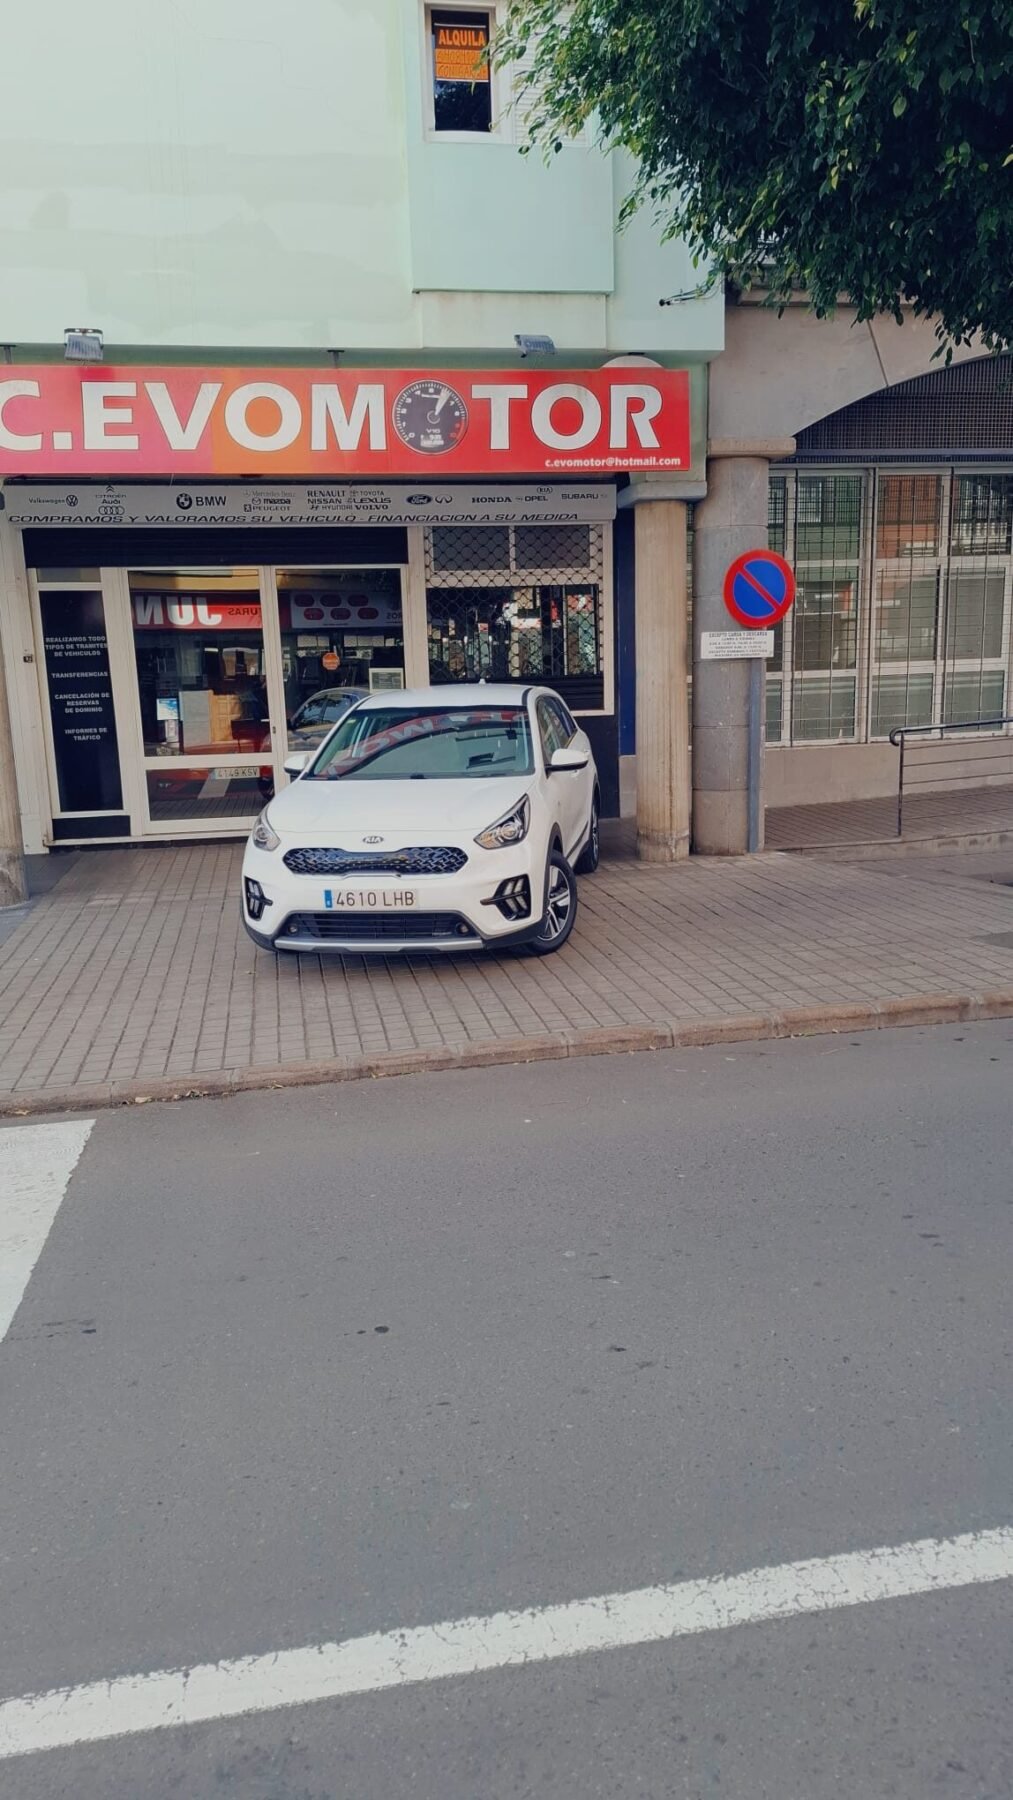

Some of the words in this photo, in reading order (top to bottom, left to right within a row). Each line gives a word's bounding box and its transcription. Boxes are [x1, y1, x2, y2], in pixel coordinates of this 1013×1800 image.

[438, 30, 486, 46] ALQUILA
[545, 456, 681, 467] c.evomotor@hotmail.com
[196, 496, 226, 506] BMW
[51, 671, 108, 679] TRANSFERENCIAS
[55, 692, 100, 700] CANCELACIÓN
[336, 892, 377, 907] 4610
[383, 892, 415, 907] LHB
